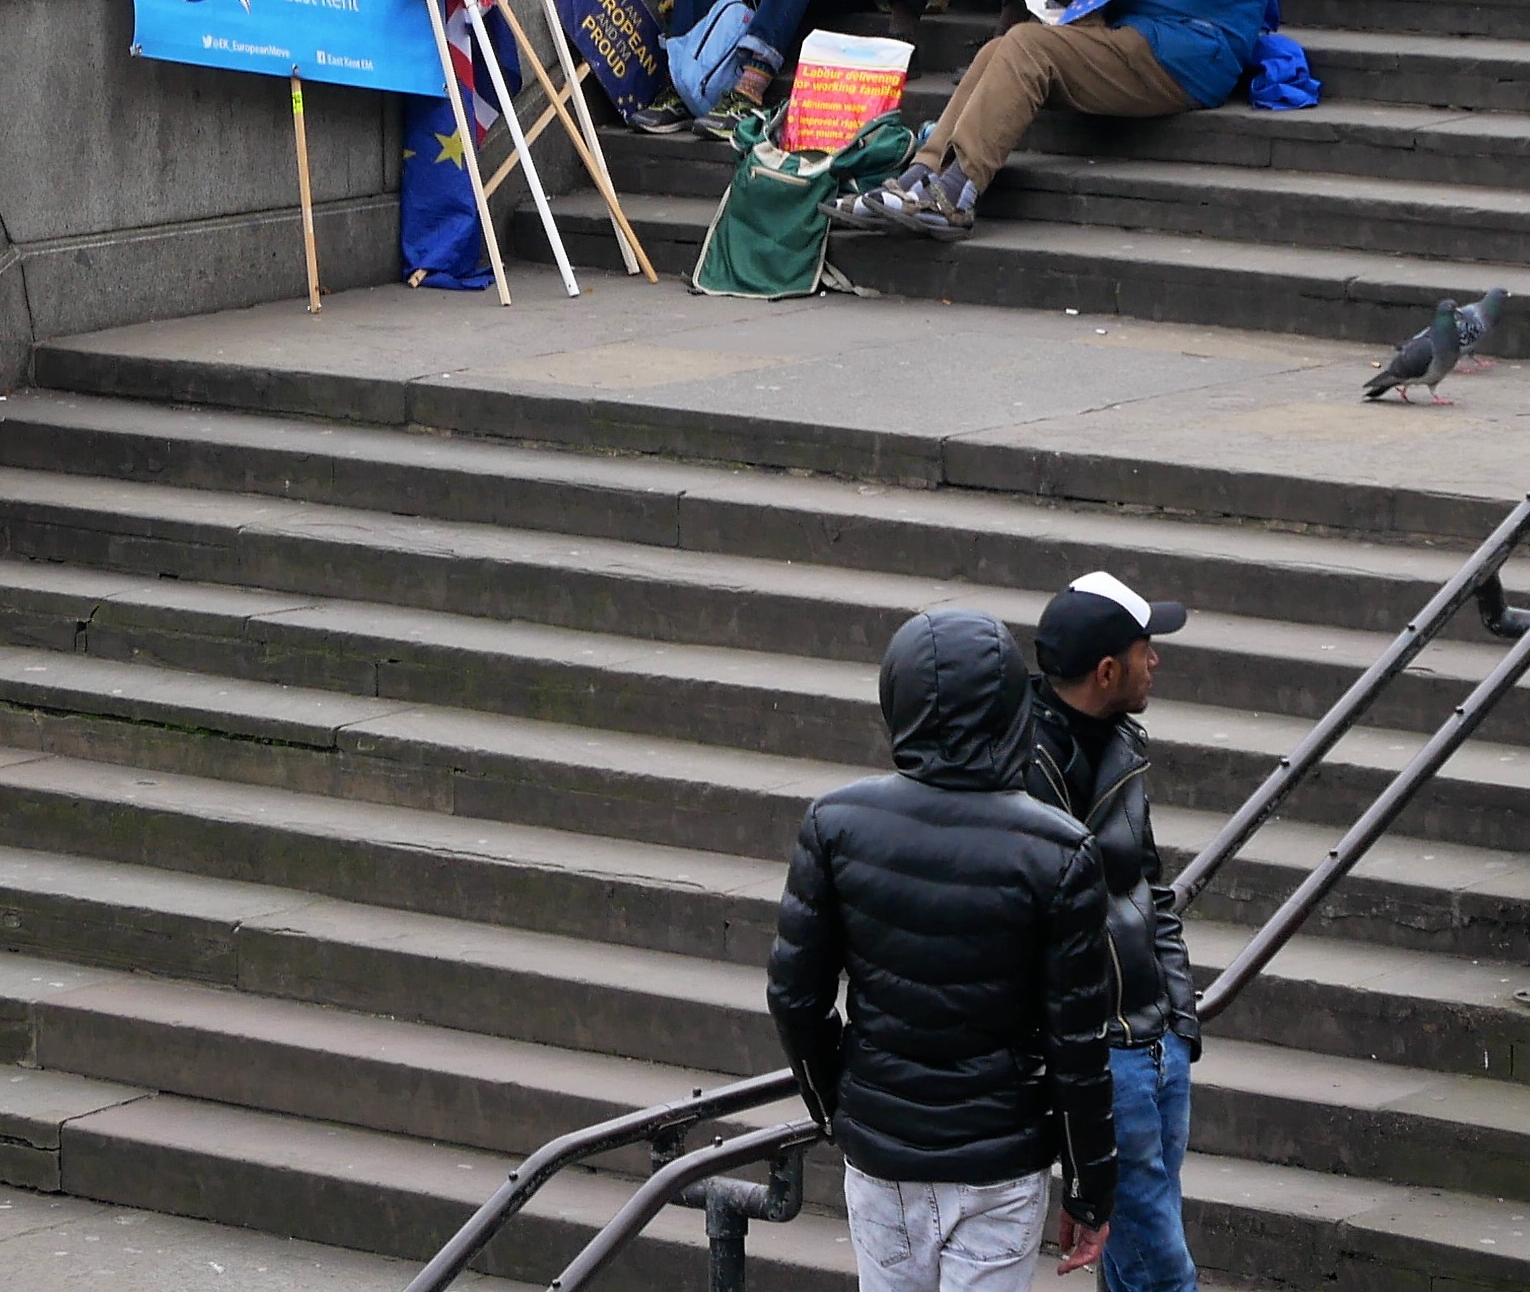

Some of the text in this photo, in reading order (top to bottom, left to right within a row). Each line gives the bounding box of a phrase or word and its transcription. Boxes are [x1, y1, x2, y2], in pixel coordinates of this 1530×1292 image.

[595, 13, 618, 41] AND
[626, 3, 643, 28] AM
[582, 15, 626, 78] PROUD
[803, 66, 901, 85] Labour delivering
[813, 82, 856, 94] working
